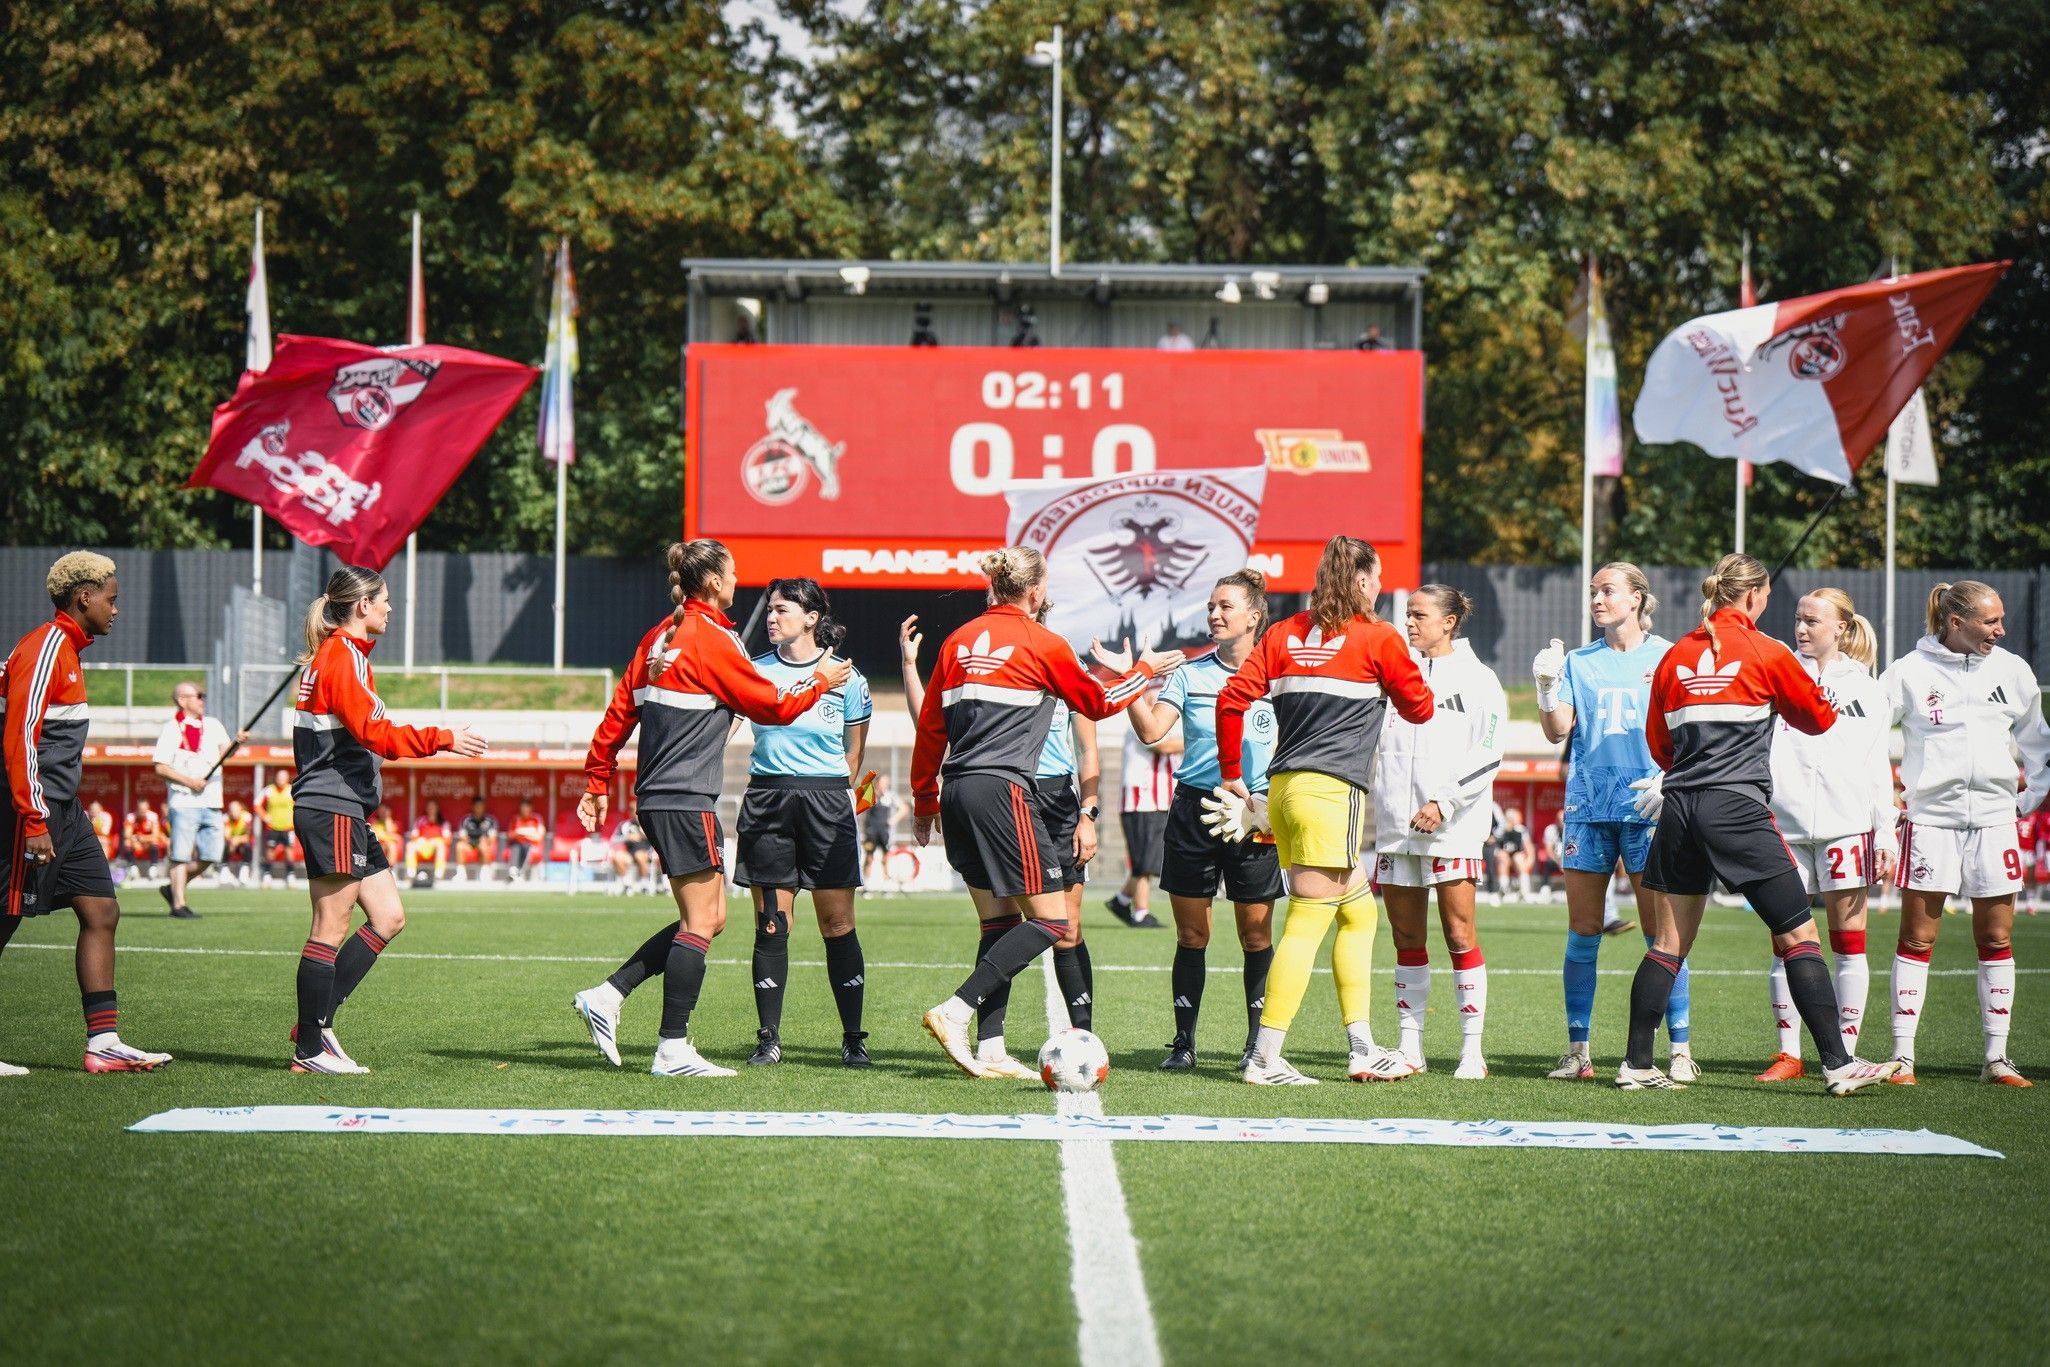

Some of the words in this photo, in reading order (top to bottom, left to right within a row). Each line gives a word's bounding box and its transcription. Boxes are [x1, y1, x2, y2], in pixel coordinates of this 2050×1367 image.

[982, 370, 1124, 410] 02:11
[821, 548, 985, 575] FRANZ-K
[1827, 845, 1863, 880] 21
[2003, 848, 2022, 881] 9
[1458, 983, 1475, 991] FC
[1842, 1006, 1860, 1015] FC
